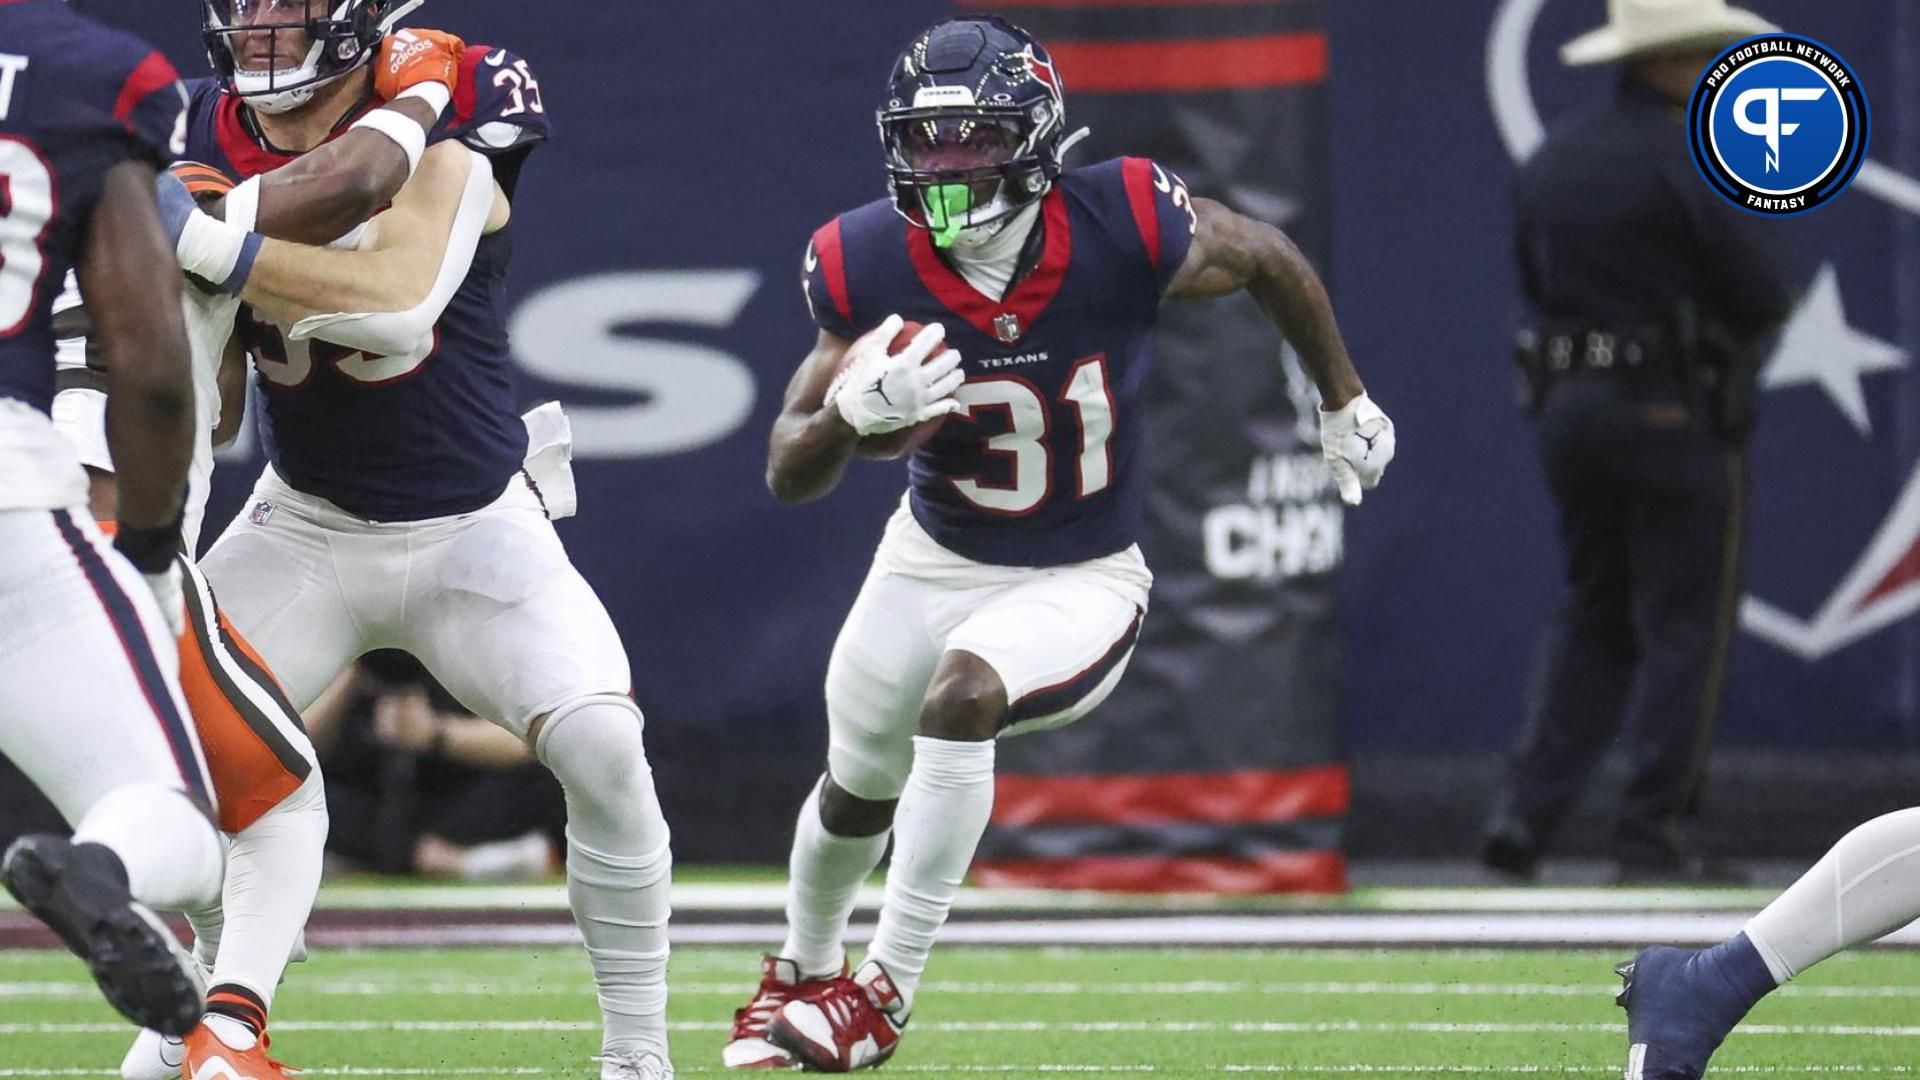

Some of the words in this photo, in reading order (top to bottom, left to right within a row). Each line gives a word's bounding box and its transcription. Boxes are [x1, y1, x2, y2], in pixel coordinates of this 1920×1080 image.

[390, 39, 433, 75] adidas
[492, 59, 545, 118] 35
[1172, 172, 1198, 235] 3
[977, 351, 1050, 369] TEXANS
[947, 353, 1117, 508] 31
